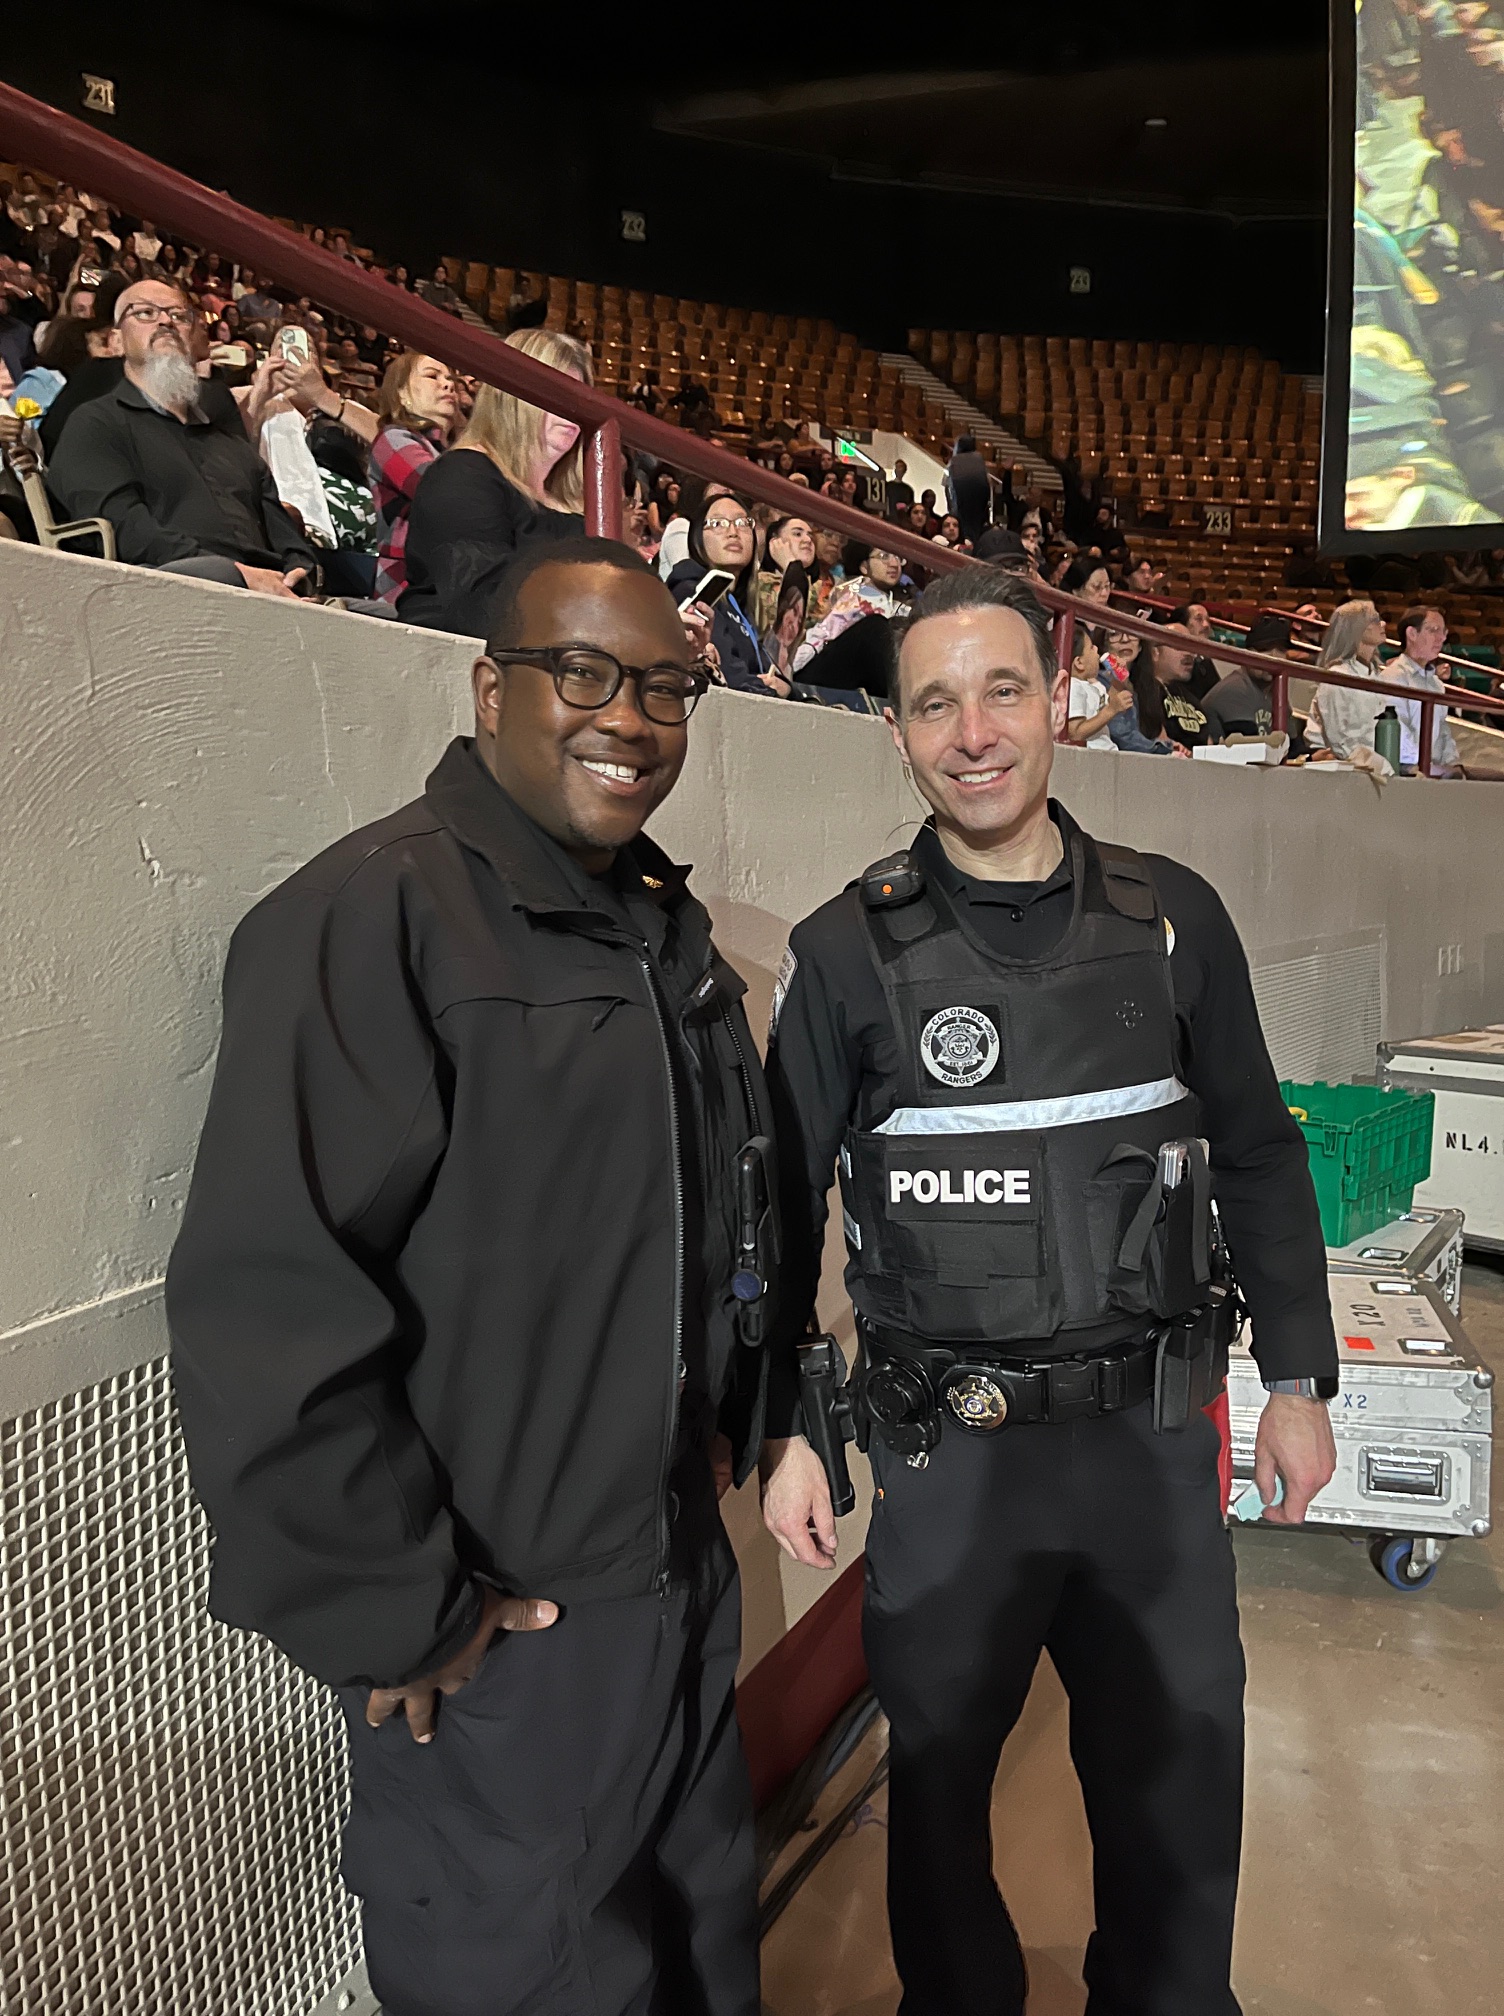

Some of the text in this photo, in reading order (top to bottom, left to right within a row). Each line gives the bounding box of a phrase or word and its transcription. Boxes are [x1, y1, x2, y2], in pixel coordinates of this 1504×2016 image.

[85, 80, 114, 107] 231
[866, 476, 886, 504] 131
[1206, 511, 1231, 534] 233
[931, 1008, 985, 1026] COLORADO
[941, 1071, 983, 1084] RANGERS
[890, 1169, 1031, 1204] POLICE
